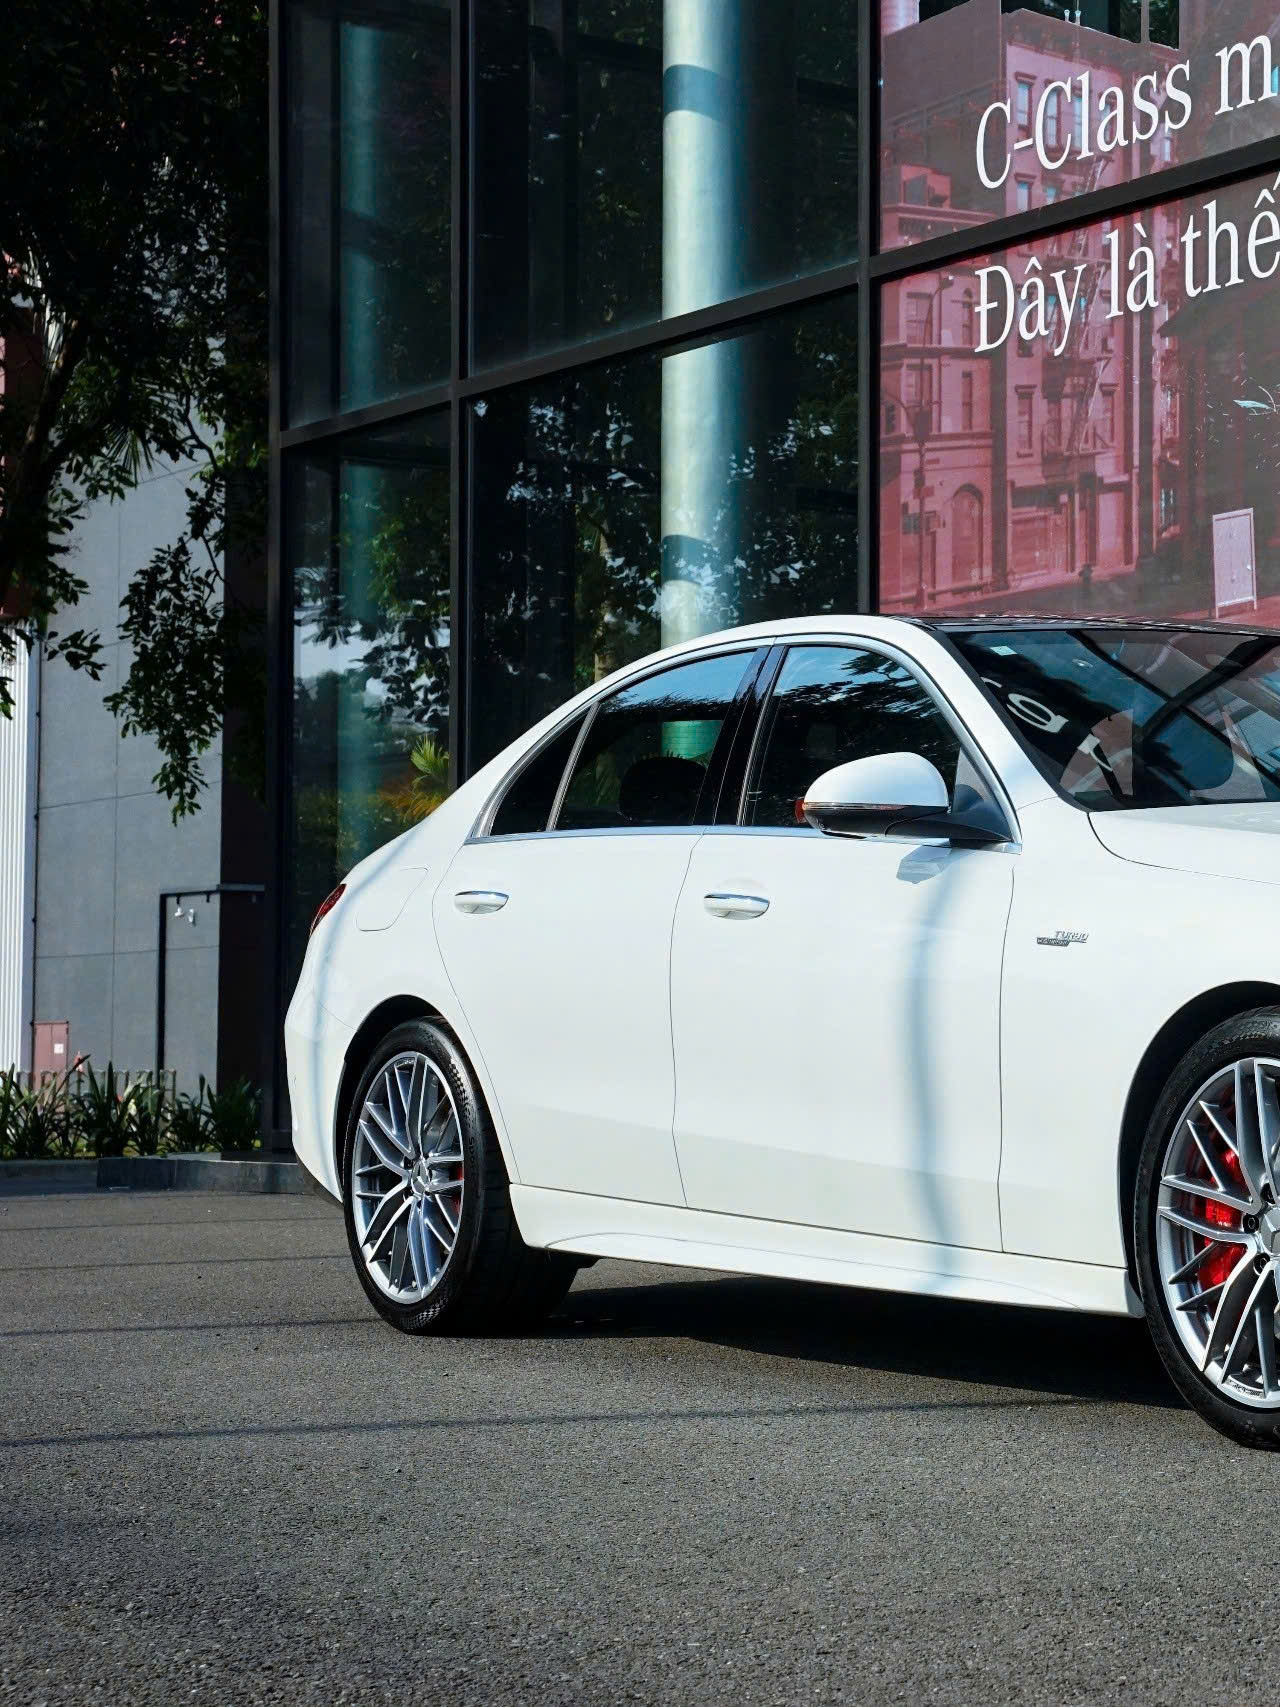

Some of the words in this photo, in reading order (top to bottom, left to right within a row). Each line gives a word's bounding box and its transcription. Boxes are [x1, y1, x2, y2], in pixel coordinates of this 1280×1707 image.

[975, 58, 1193, 190] C-Class
[973, 256, 1088, 357] Đây
[1104, 223, 1159, 320] là
